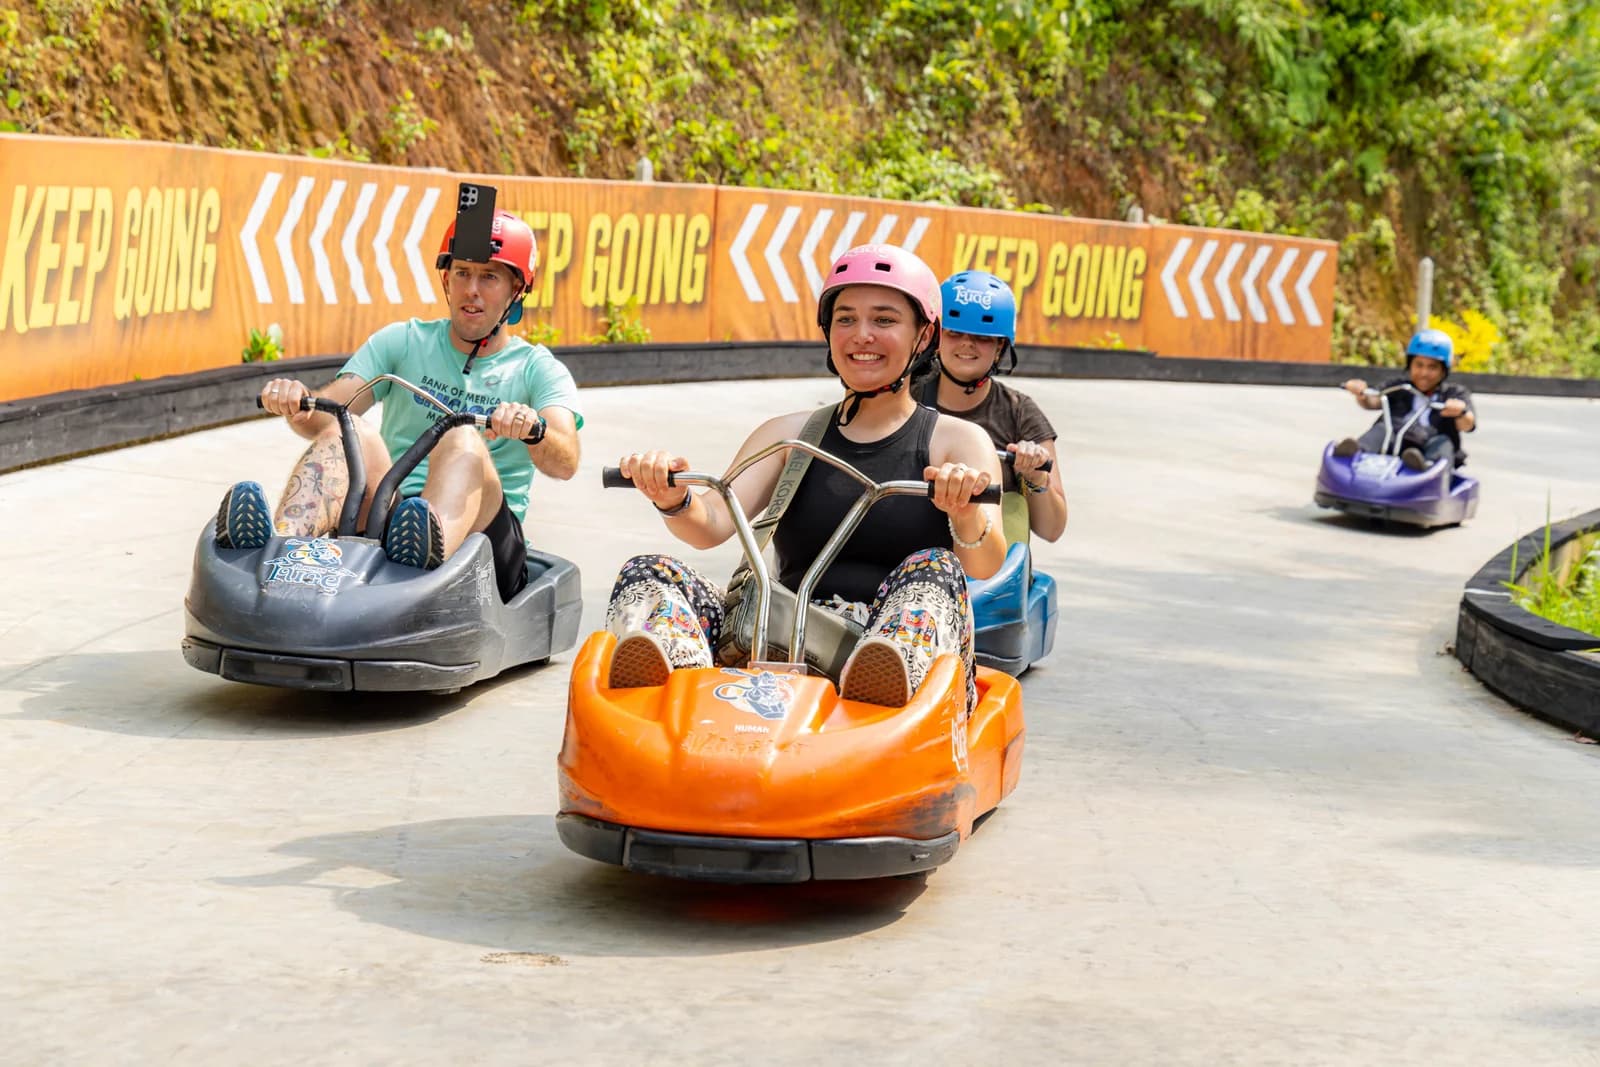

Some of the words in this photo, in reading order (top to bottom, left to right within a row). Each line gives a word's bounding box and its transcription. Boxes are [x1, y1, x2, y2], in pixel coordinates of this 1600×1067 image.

[0, 185, 114, 334] KEEP
[114, 186, 221, 321] GOING
[508, 211, 574, 308] EP
[581, 213, 711, 308] GOING
[1042, 241, 1147, 320] GOING
[421, 375, 449, 393] BANK
[450, 387, 464, 399] OF
[768, 480, 795, 516] KORS
